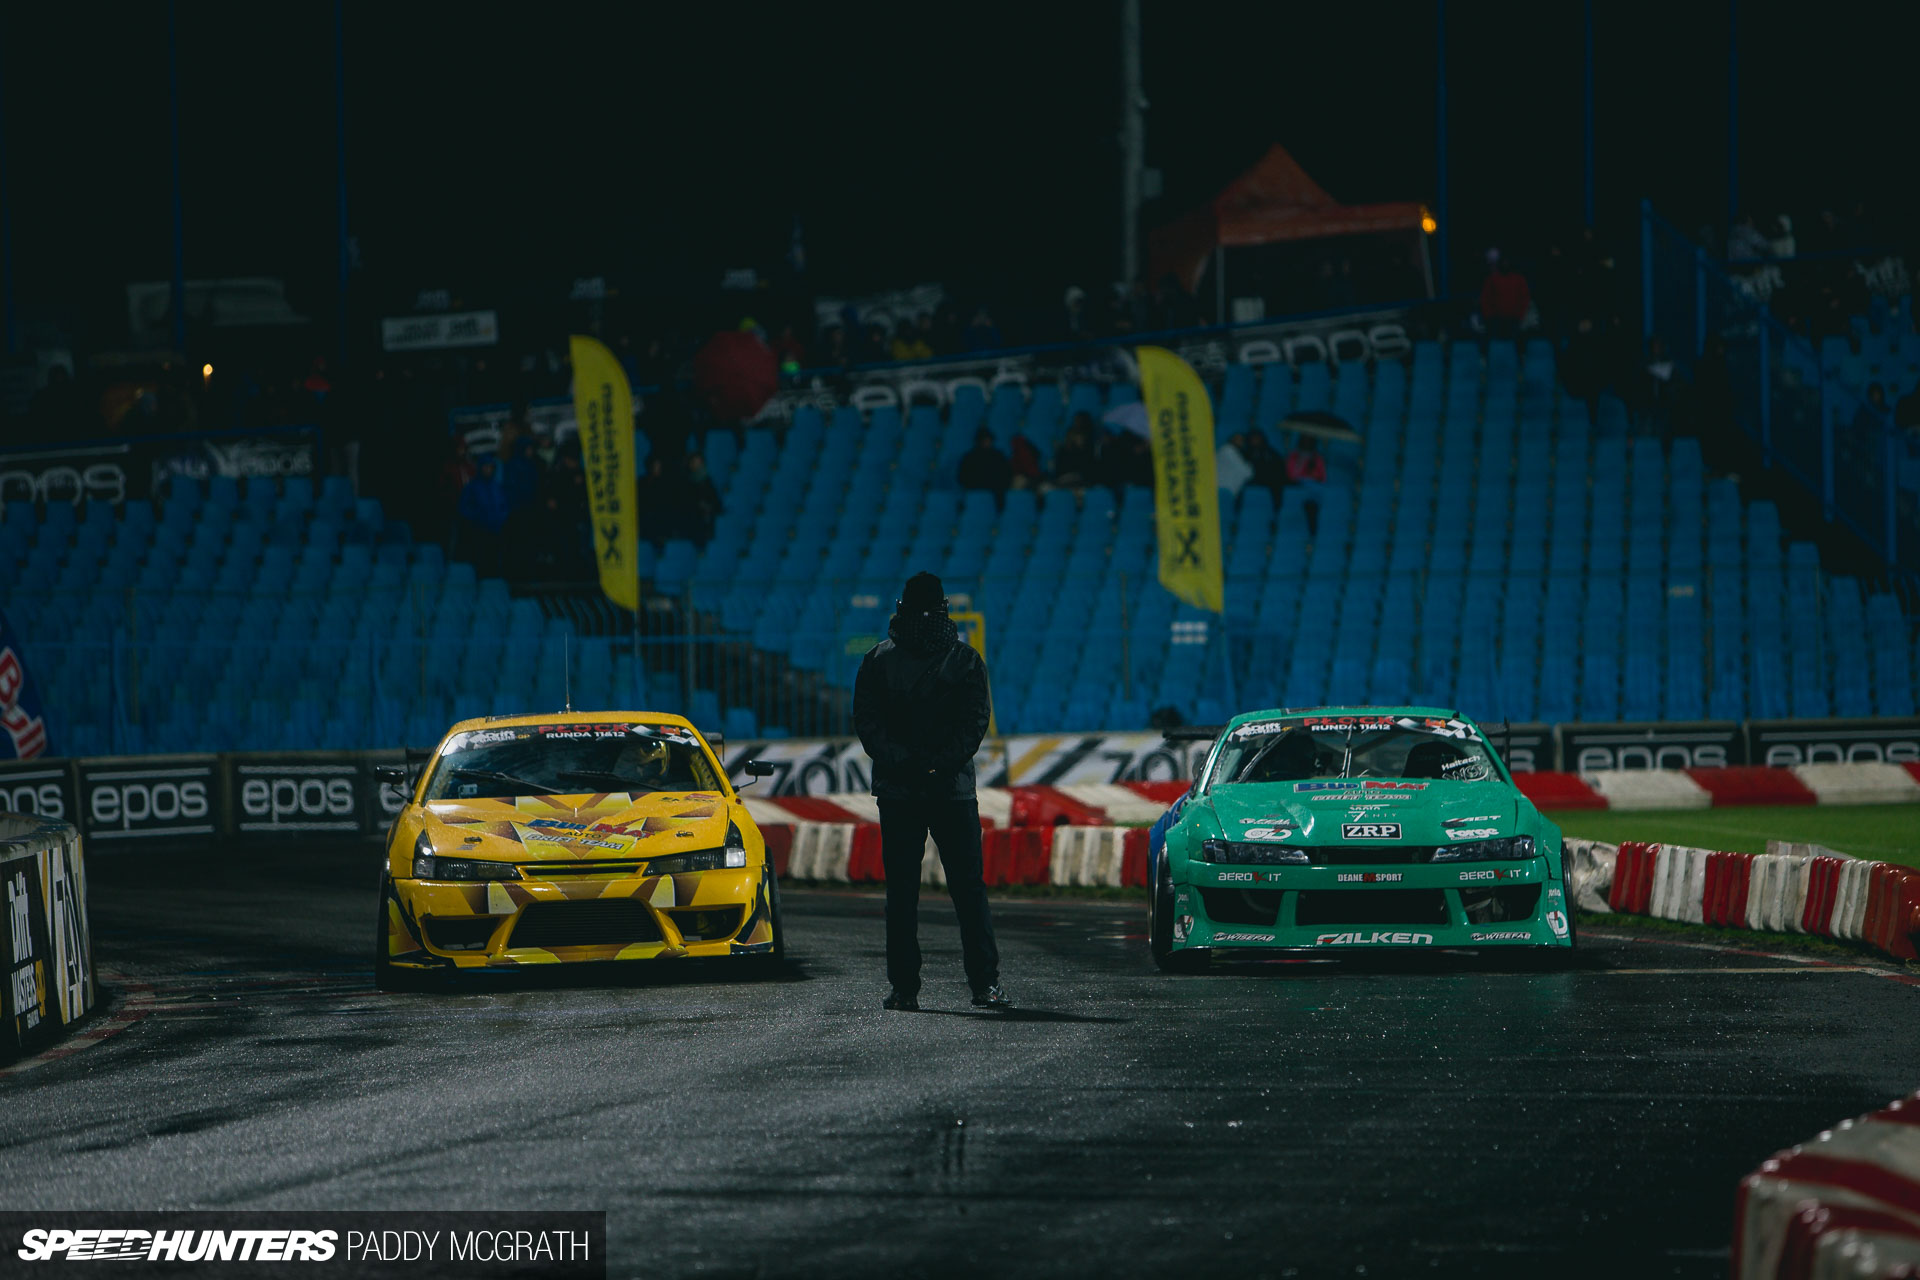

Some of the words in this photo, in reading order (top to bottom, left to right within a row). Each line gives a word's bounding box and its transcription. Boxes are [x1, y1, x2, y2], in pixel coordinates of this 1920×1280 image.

[1441, 755, 1480, 771] Haltech
[91, 782, 208, 830] epos
[242, 778, 354, 823] epos
[1346, 825, 1396, 837] ZRP
[1445, 828, 1499, 838] Forge
[525, 833, 576, 843] DRIFT
[578, 839, 625, 850] TEAM
[1317, 932, 1433, 945] FALKEN
